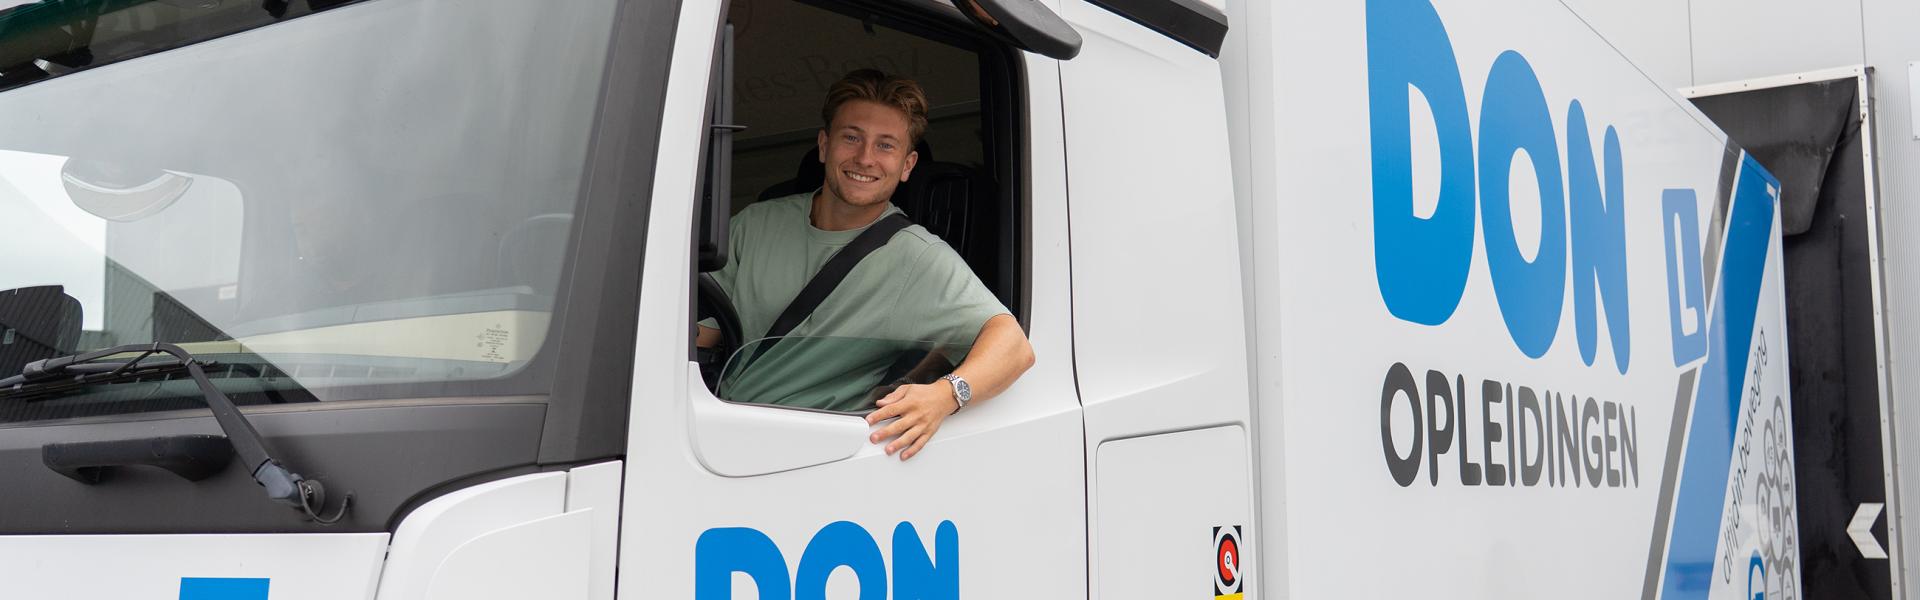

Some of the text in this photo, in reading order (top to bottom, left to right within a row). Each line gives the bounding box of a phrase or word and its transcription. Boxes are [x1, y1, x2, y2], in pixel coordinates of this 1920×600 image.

[1365, 0, 1631, 375] DON
[1674, 212, 1699, 337] L
[1380, 361, 1639, 489] OPLEIDINGEN
[695, 519, 960, 600] DON
